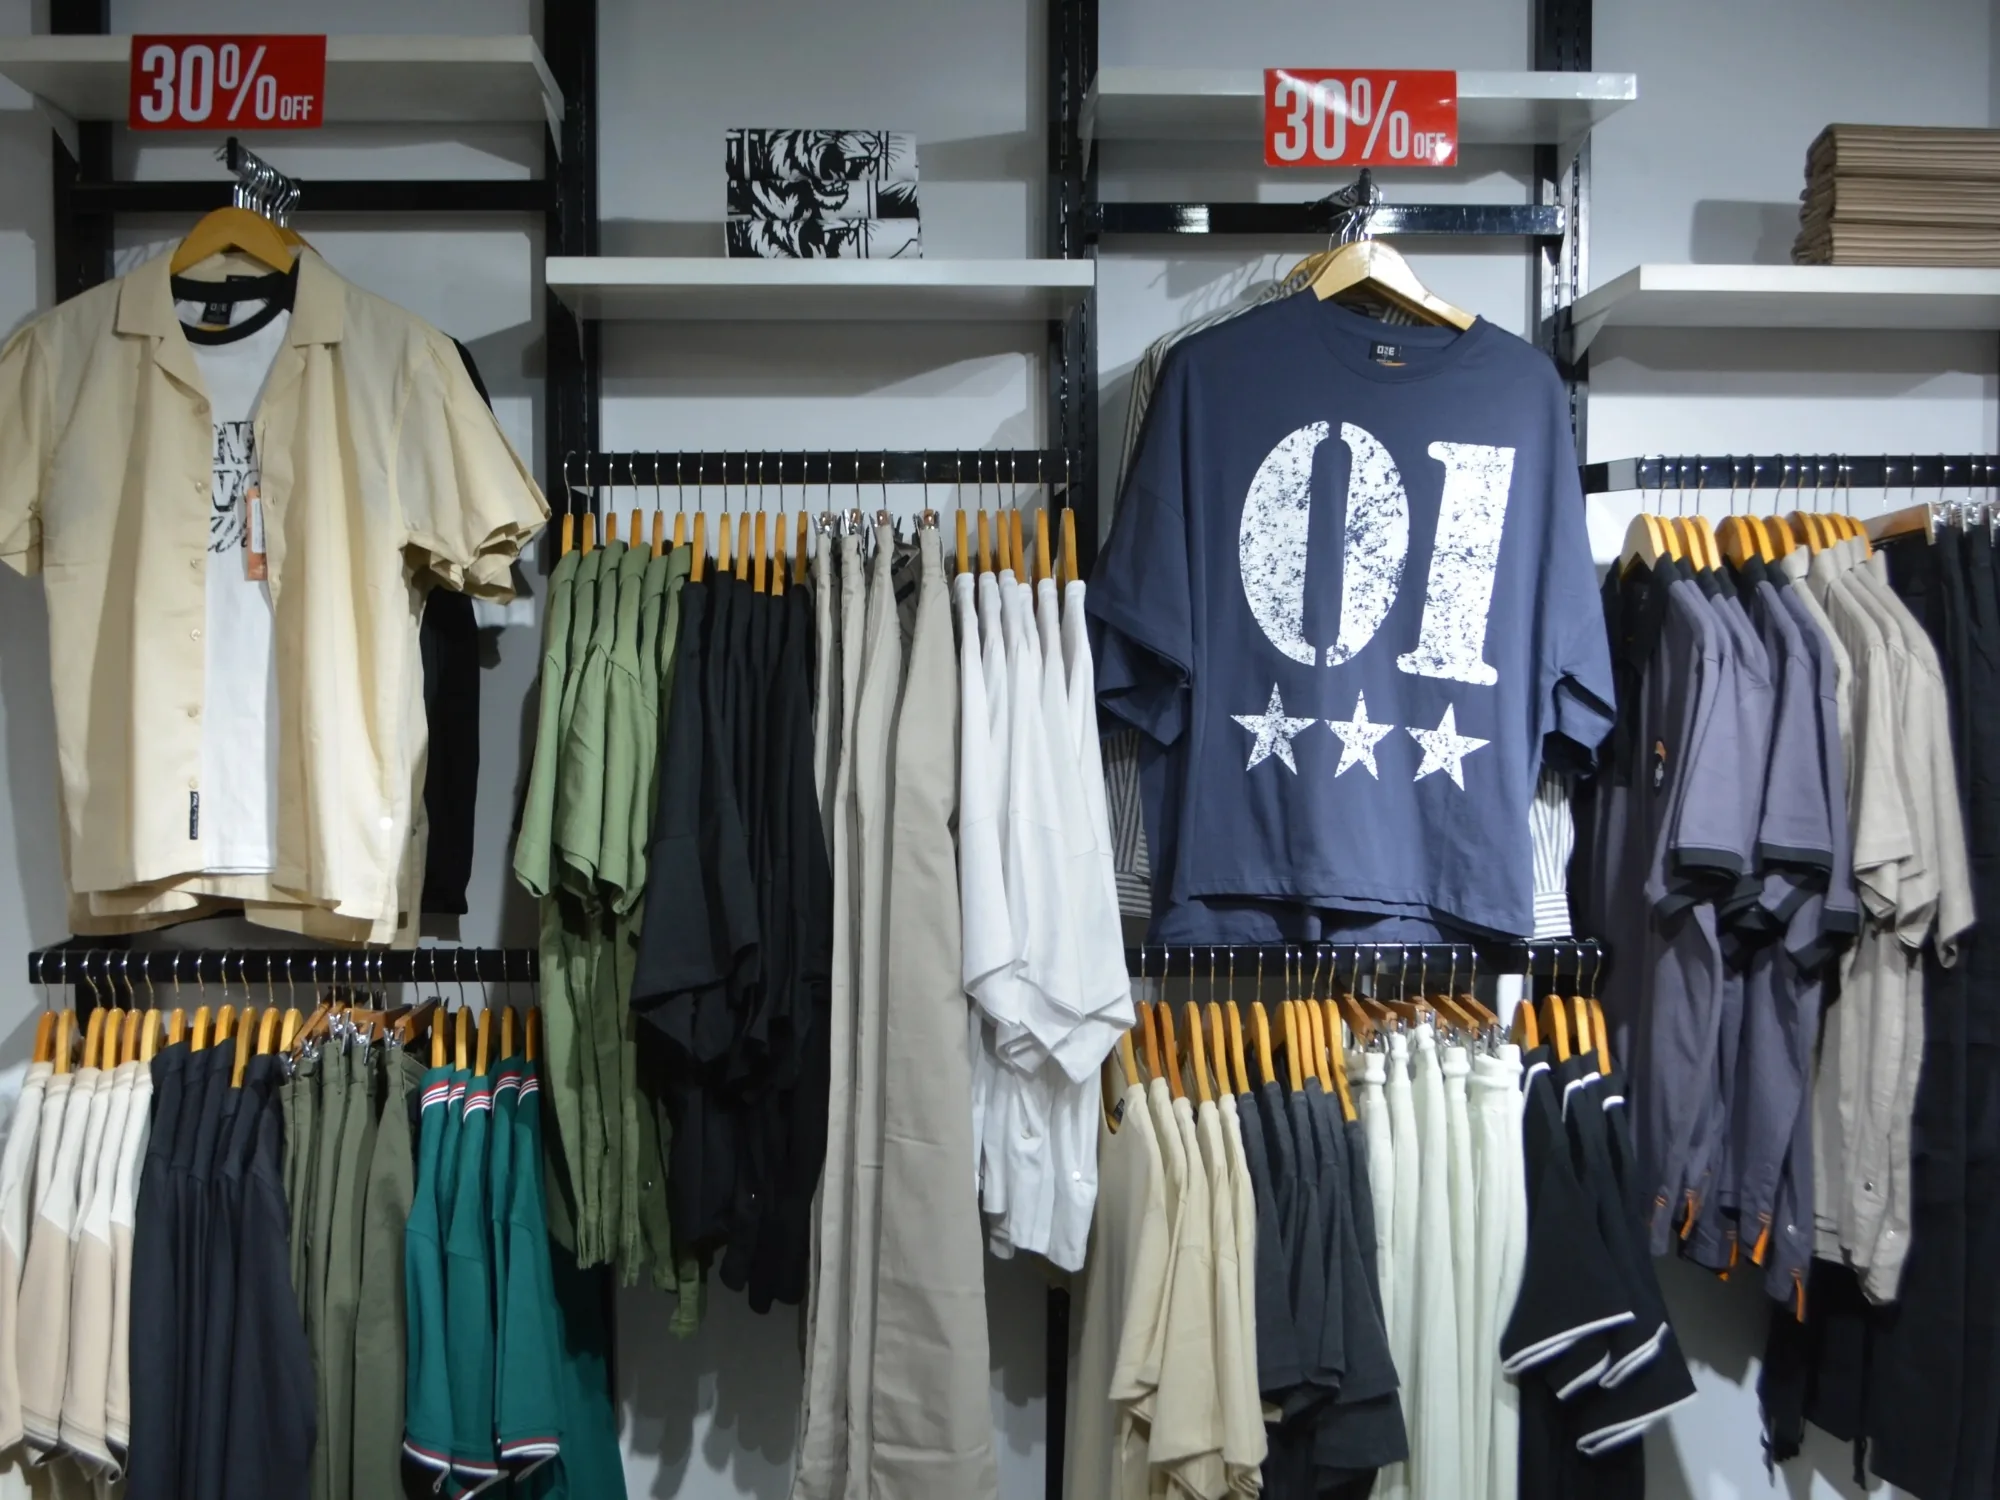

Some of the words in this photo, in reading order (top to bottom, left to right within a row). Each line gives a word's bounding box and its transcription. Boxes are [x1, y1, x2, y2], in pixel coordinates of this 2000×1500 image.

[140, 43, 277, 123] 30%
[279, 95, 313, 121] OFF
[1273, 77, 1409, 161] 30%
